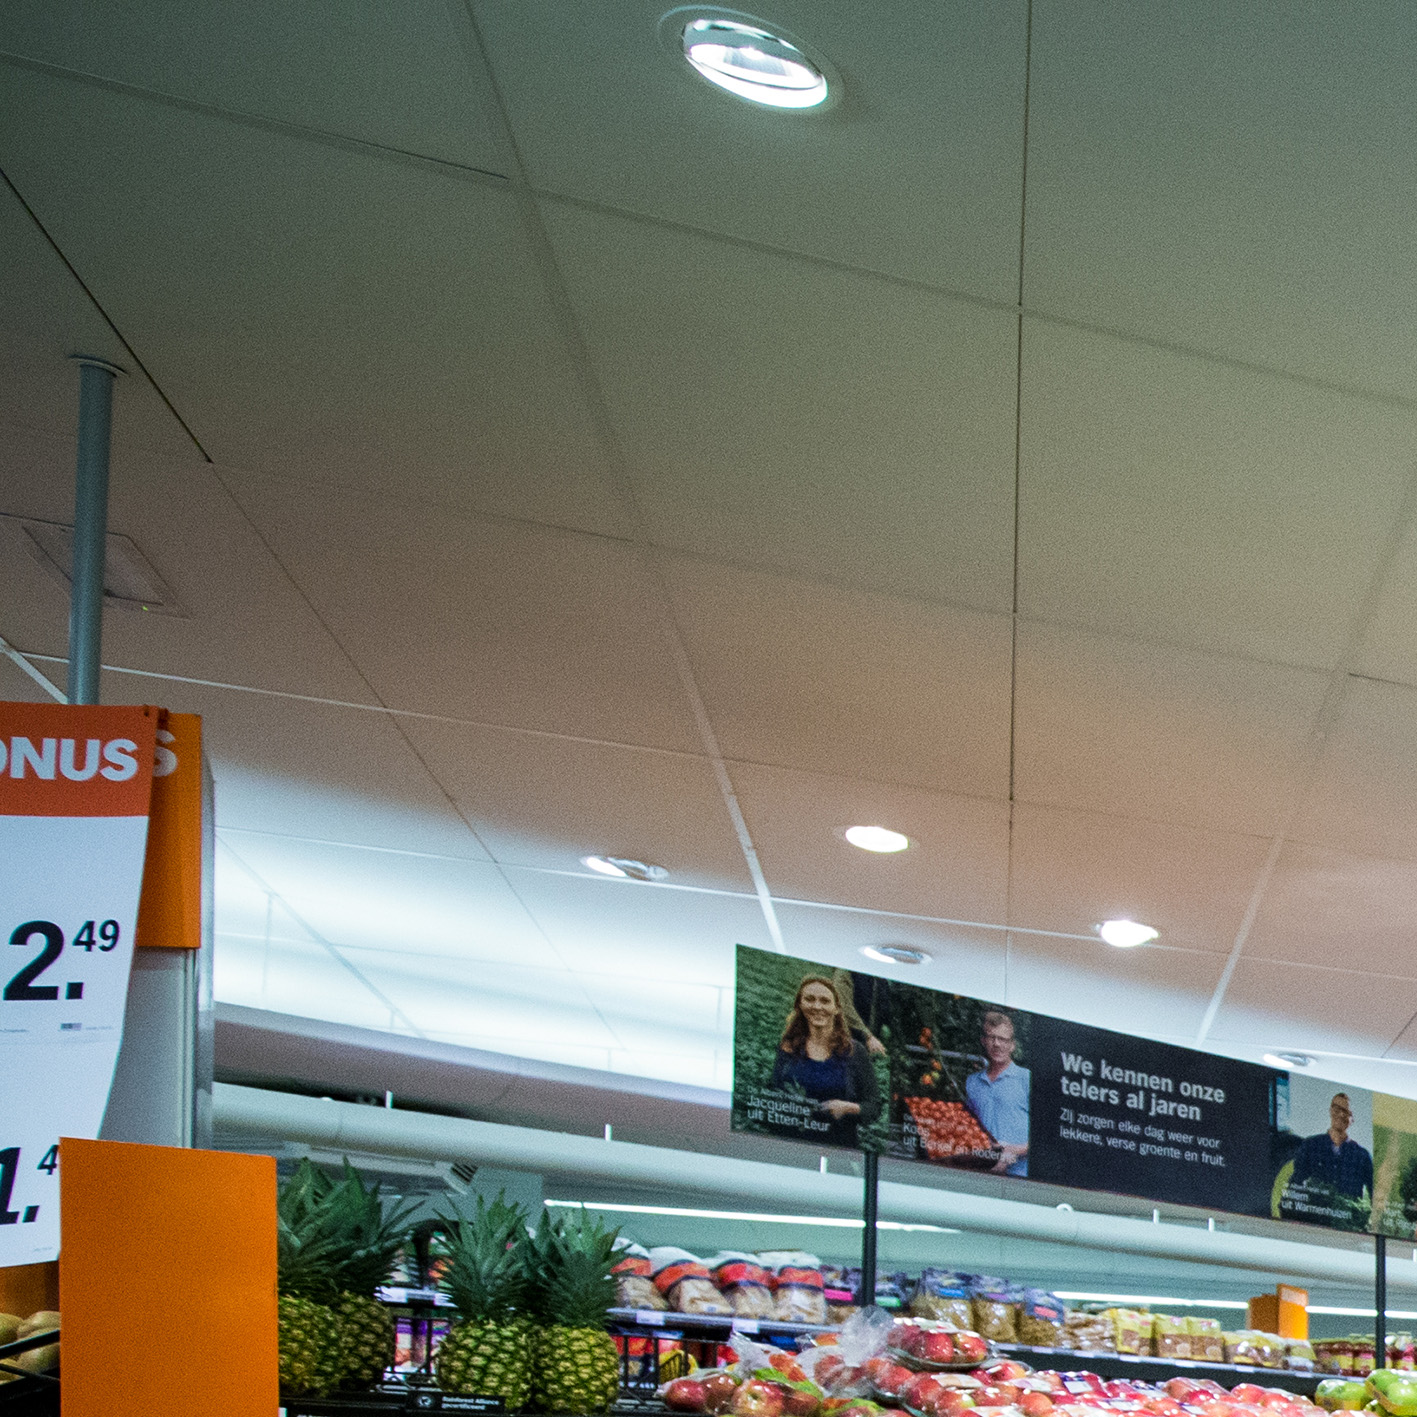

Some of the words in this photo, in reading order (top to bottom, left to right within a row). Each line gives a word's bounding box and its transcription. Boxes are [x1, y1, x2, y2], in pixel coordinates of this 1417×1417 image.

[0, 737, 138, 781] NUS
[2, 919, 120, 1001] 2.49
[1061, 1051, 1094, 1076] We
[1100, 1059, 1173, 1092] kennen
[1179, 1081, 1225, 1103] onze
[747, 1095, 810, 1116] Jacqueline
[1060, 1076, 1119, 1105] telers
[1126, 1090, 1144, 1109] al
[1150, 1093, 1201, 1121] jaren
[747, 1109, 763, 1121] uit
[767, 1110, 830, 1132] Etten-Leur
[1060, 1107, 1073, 1123] Zij
[1077, 1113, 1114, 1129] zorgen
[1118, 1119, 1140, 1135] elke
[1145, 1125, 1163, 1141] dag
[1168, 1129, 1194, 1143] weer
[1197, 1136, 1220, 1148] voor
[903, 1136, 916, 1146] uit
[1059, 1126, 1103, 1145] lekkere,
[1106, 1136, 1135, 1150] verse
[1140, 1143, 1180, 1159] groente
[1184, 1150, 1198, 1162] en
[1202, 1152, 1225, 1166] fruit.
[1281, 1201, 1293, 1210] uit
